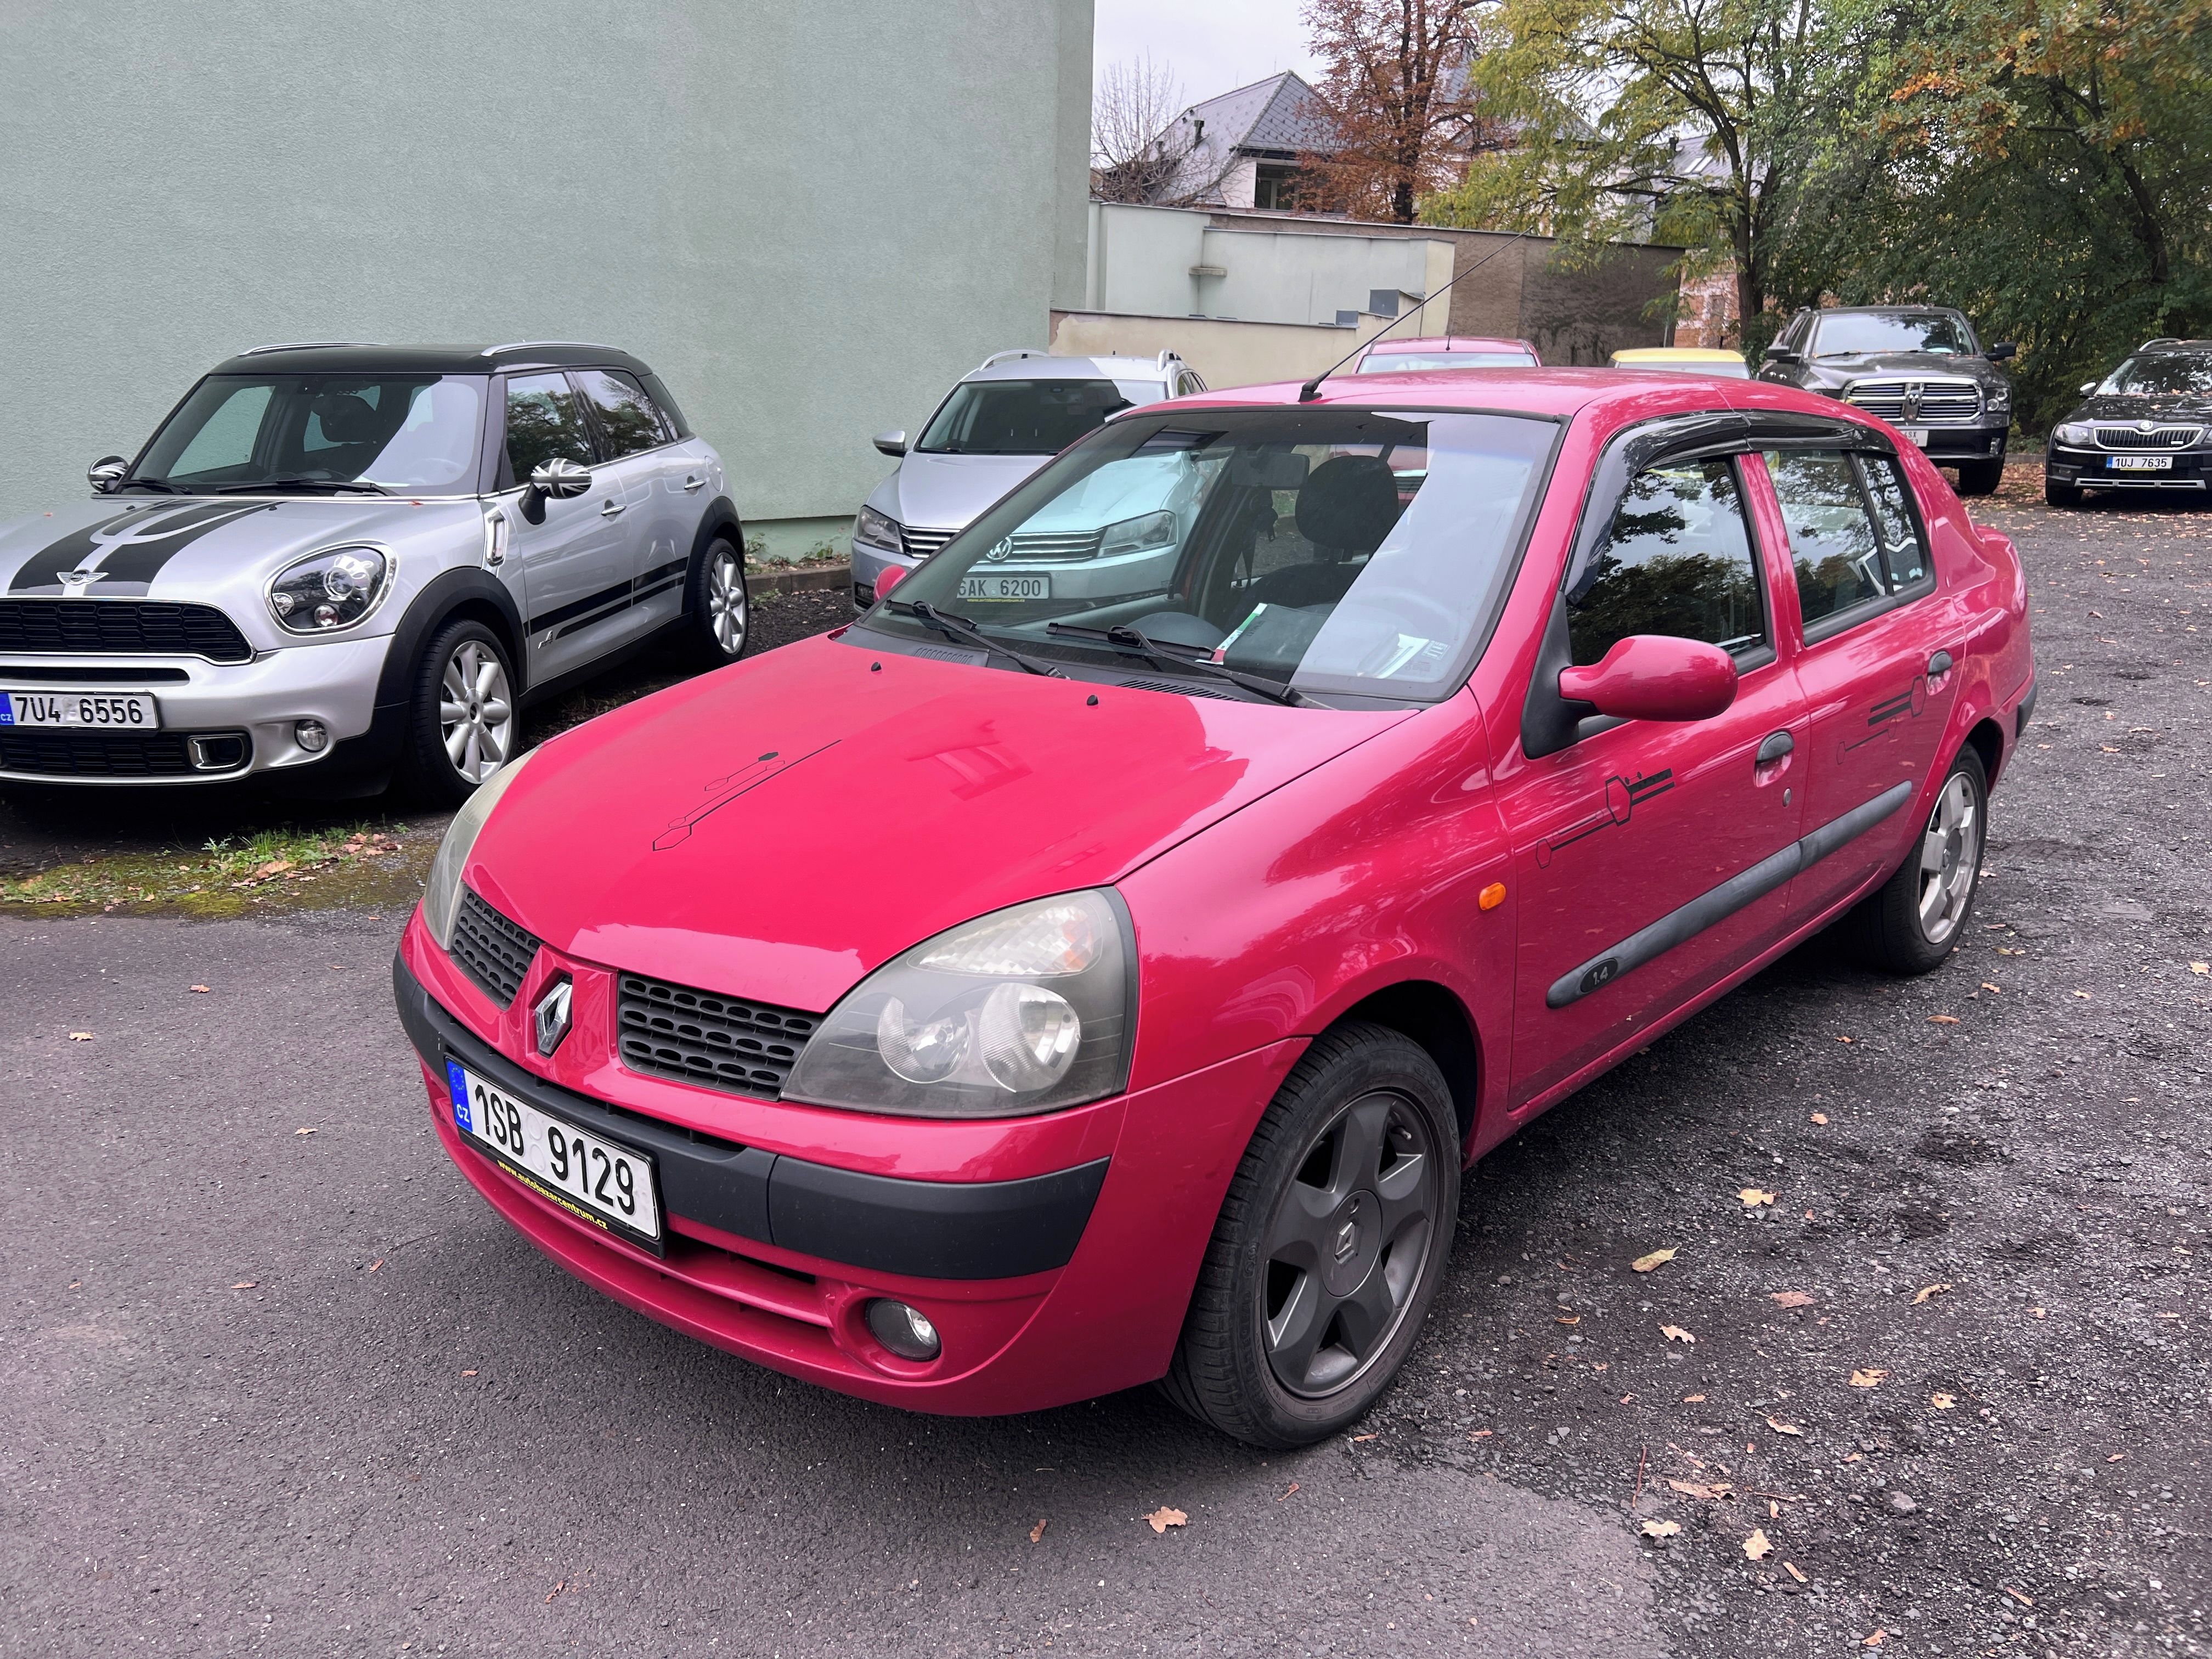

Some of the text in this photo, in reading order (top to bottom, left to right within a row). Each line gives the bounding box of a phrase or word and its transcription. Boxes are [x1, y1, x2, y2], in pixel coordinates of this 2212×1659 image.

[2115, 458, 2133, 467] 1UJ
[2142, 458, 2167, 467] 7635
[1000, 579, 1041, 596] 6200
[14, 697, 60, 723] 7U4
[79, 698, 143, 724] 6556
[1593, 966, 1608, 985] 1.4
[456, 1084, 634, 1215] CZ 1SB 9129
[497, 1160, 608, 1230] www.autobazarcentrum.cz
